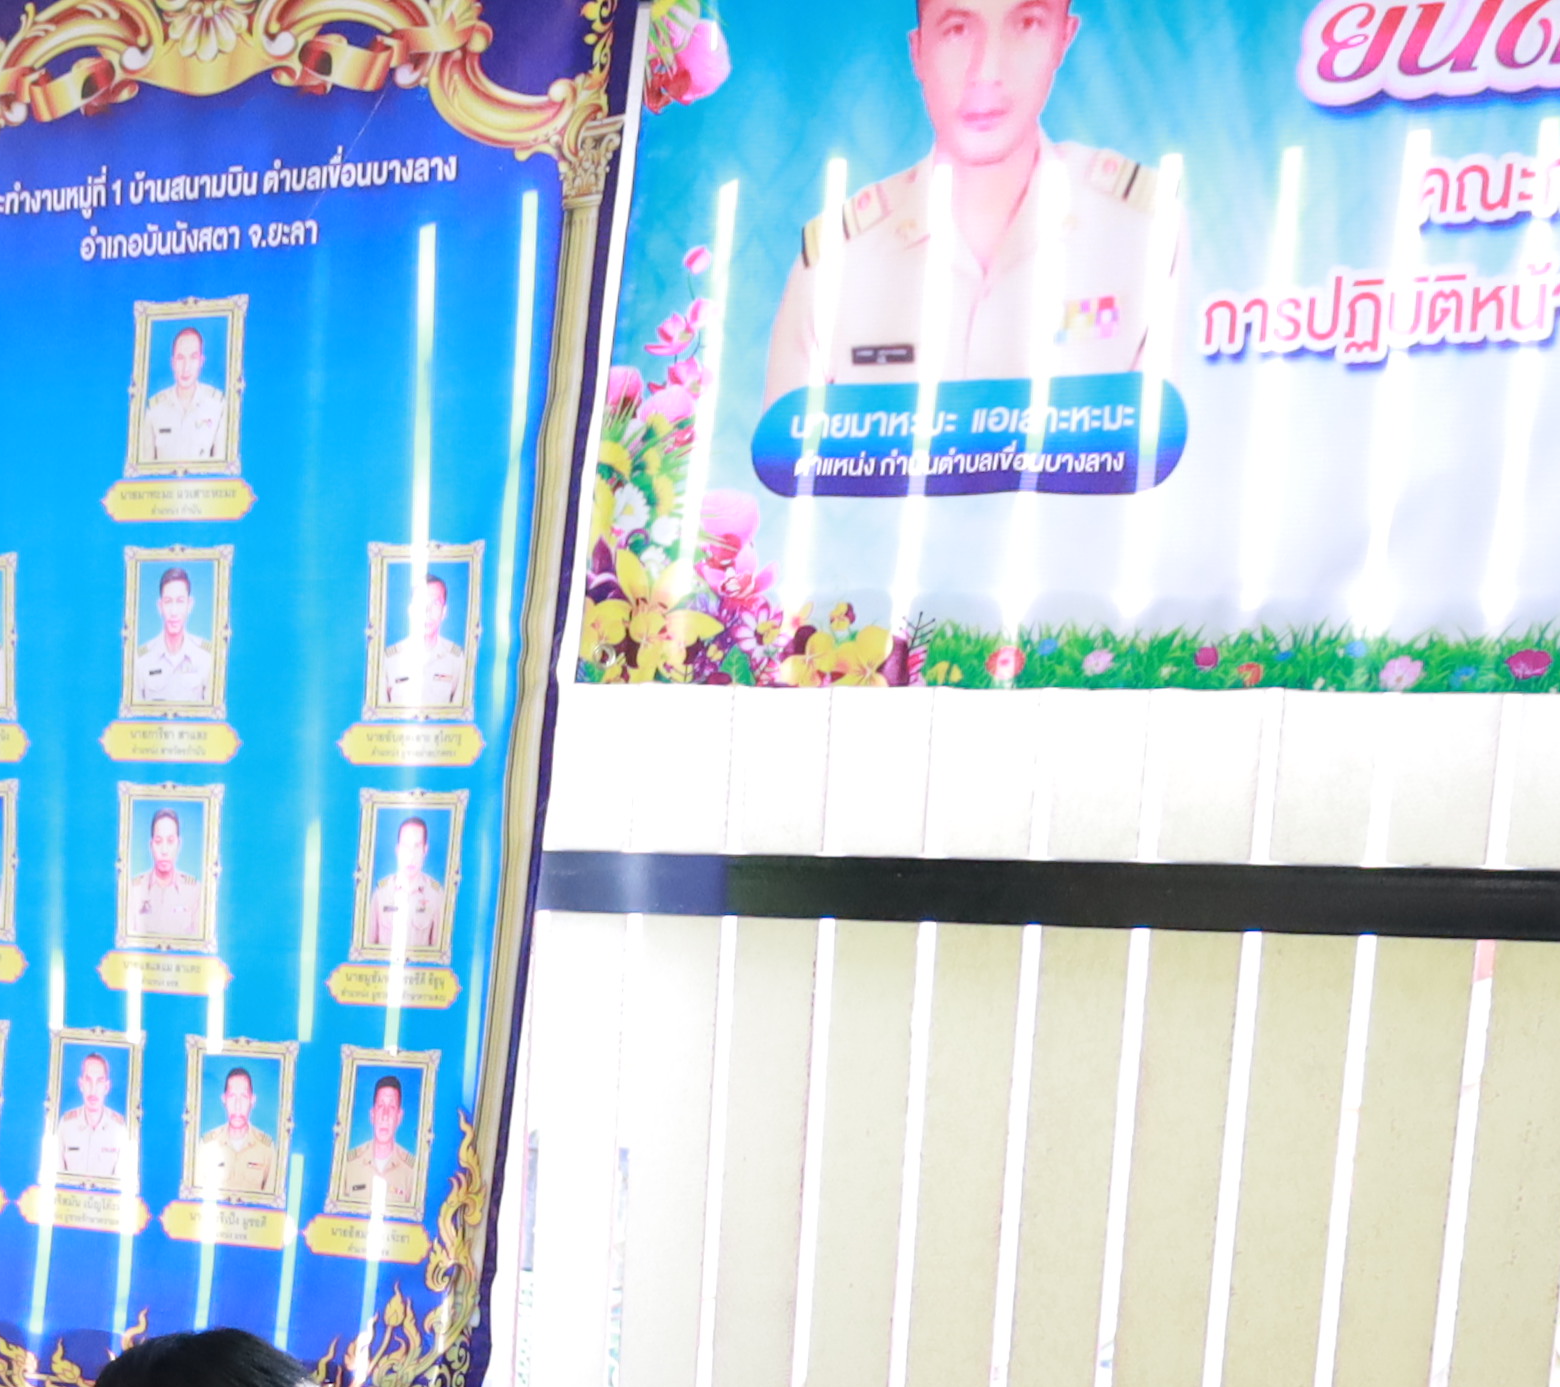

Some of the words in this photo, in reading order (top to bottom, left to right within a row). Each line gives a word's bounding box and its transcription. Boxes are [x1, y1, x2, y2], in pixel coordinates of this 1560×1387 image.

[112, 180, 122, 205] 1
[130, 165, 258, 206] บ้านสนามบิน
[263, 145, 458, 195] ตำบลเขื่อนบางลาง
[80, 221, 240, 261] อำเภอบันนังสตา
[248, 219, 318, 249] จ.ยะลา
[880, 439, 1126, 478] กำนตำบลเขื่อนบางลาง
